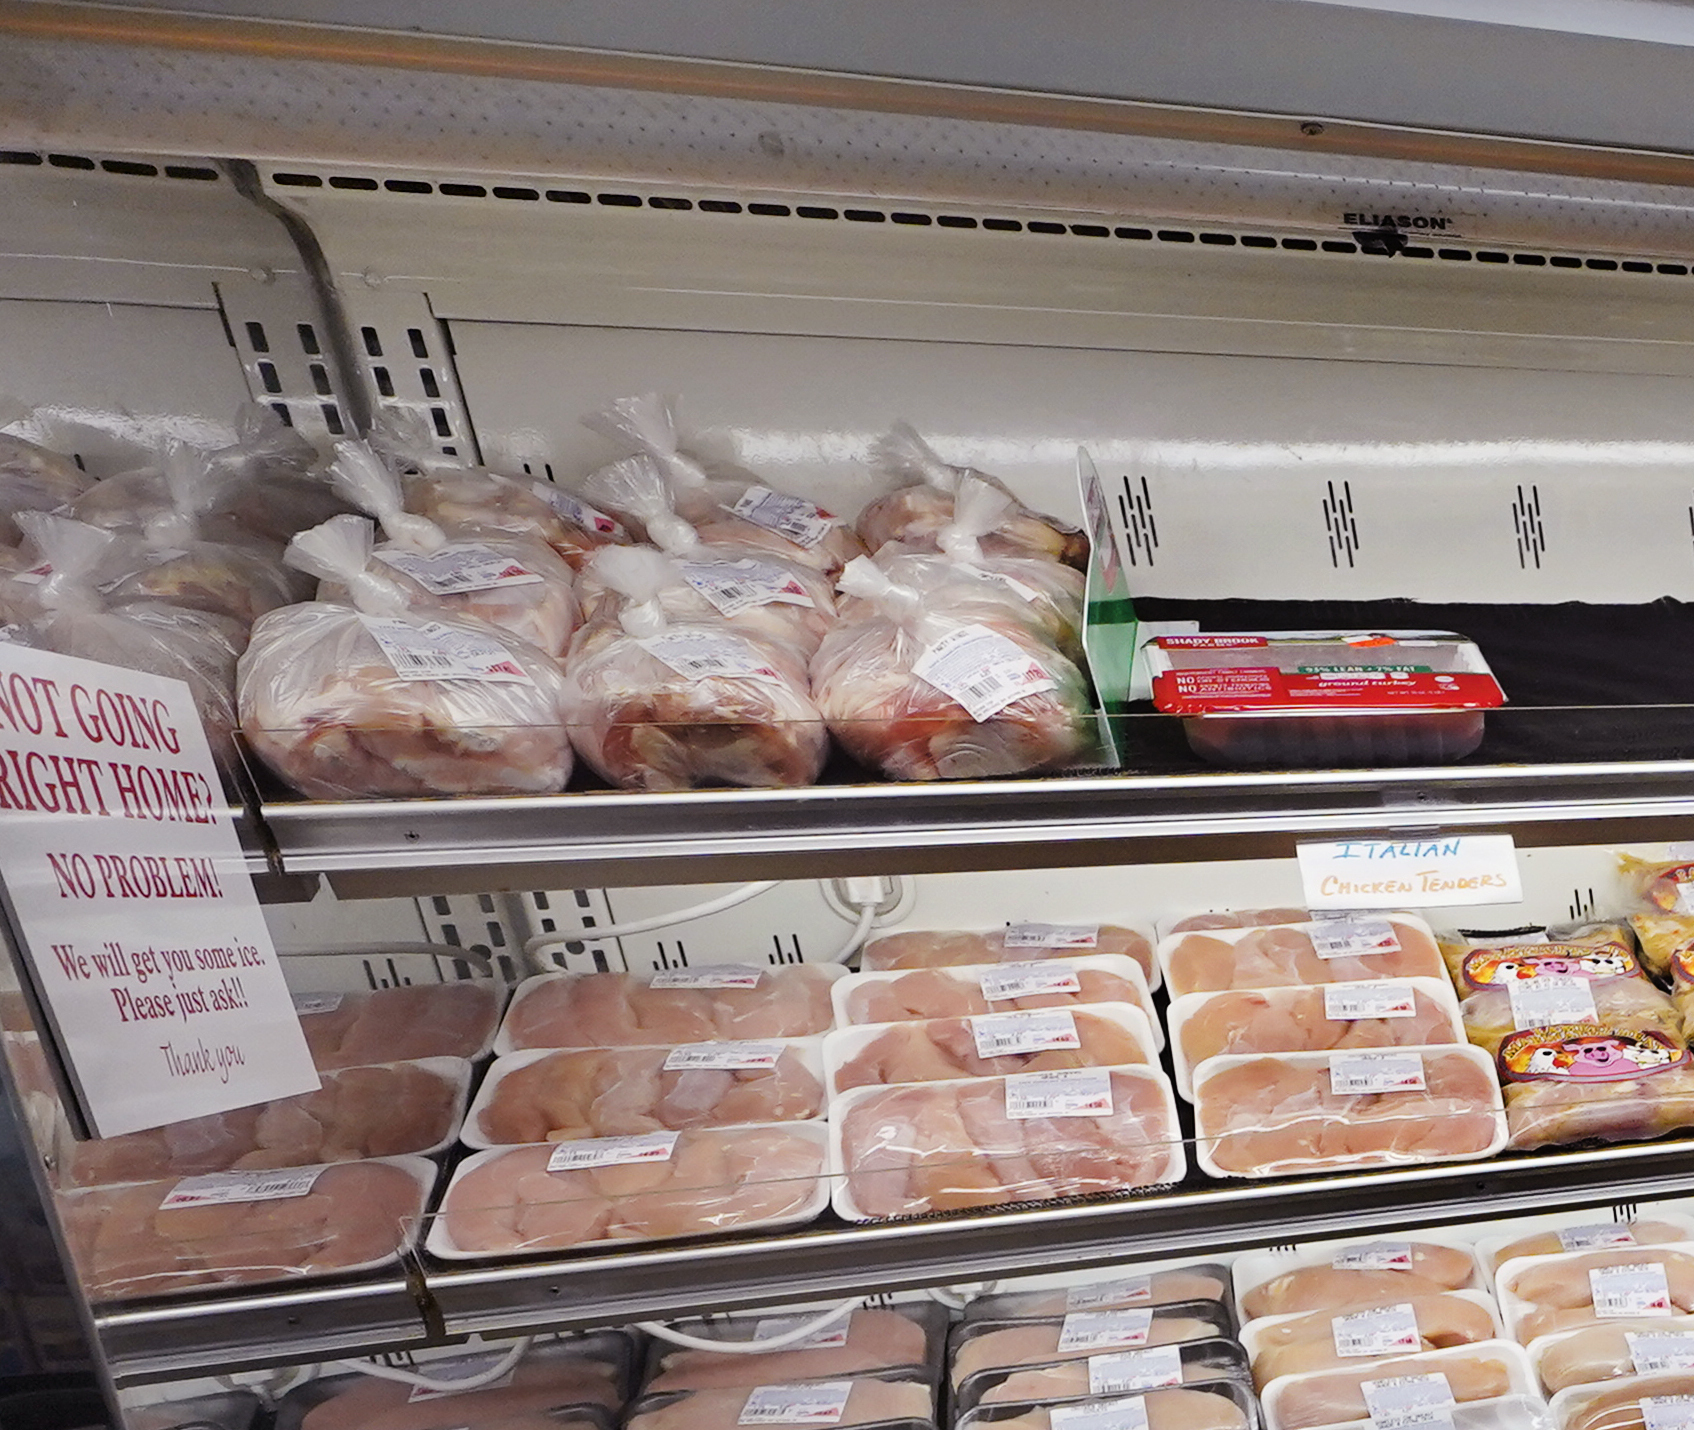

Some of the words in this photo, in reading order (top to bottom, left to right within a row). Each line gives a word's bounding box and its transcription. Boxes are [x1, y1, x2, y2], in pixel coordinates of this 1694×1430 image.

[1343, 212, 1448, 231] ELIASON
[1212, 637, 1259, 645] BROOK
[1178, 685, 1197, 693] NO
[70, 684, 180, 755] GOING
[108, 762, 217, 825] HOME?
[1333, 838, 1460, 859] ITALIAN
[46, 853, 97, 899] NO
[94, 854, 223, 899] PROBLEM!
[1321, 875, 1412, 896] CHICKEN
[1416, 870, 1507, 892] TENDERS
[51, 944, 91, 980] We
[92, 942, 132, 979] will
[131, 946, 161, 983] get
[160, 948, 194, 981] you
[194, 945, 238, 969] some
[235, 937, 266, 966] ice.
[111, 987, 176, 1022] Please
[172, 982, 210, 1023] just
[212, 976, 249, 1010] ask!!
[159, 1038, 216, 1077] Thank
[215, 1044, 245, 1084] you
